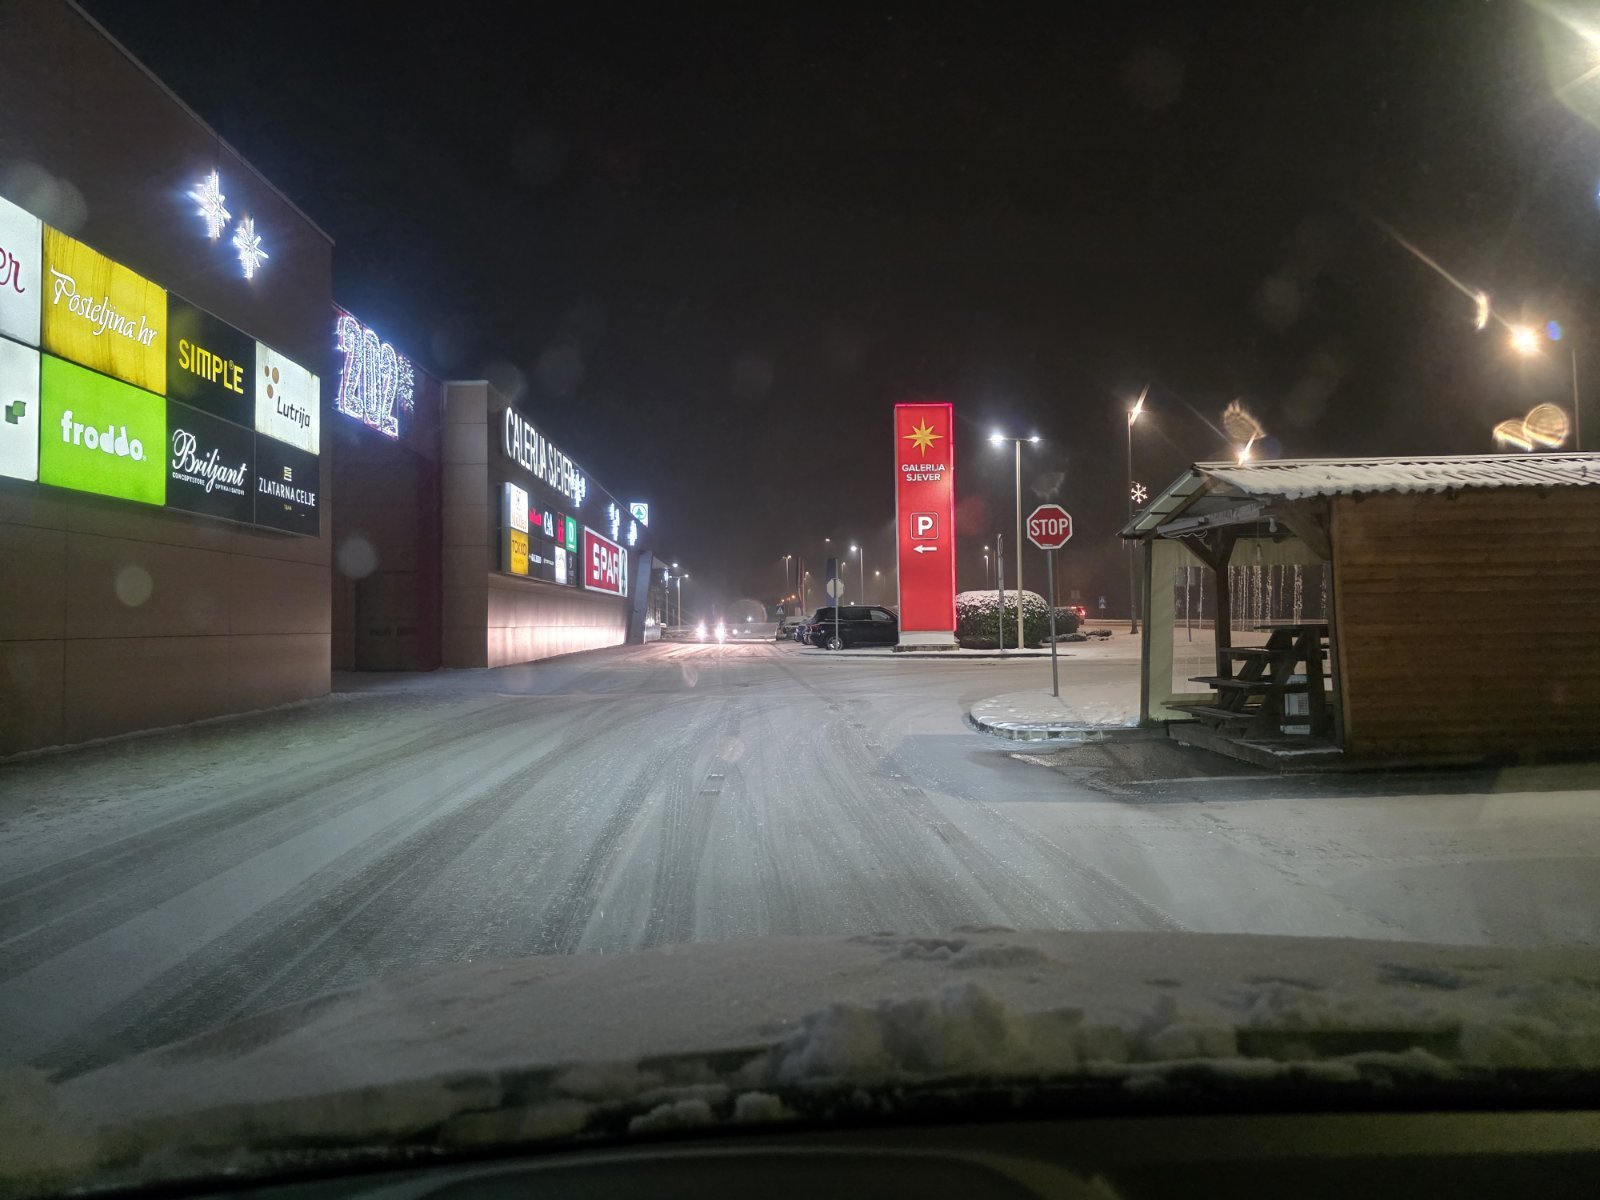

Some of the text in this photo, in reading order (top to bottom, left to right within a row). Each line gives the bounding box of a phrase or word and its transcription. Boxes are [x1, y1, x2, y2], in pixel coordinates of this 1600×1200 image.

[51, 264, 158, 347] Posteljina.hr
[276, 396, 311, 429] Lutrija
[172, 428, 248, 494] Briljant
[901, 463, 946, 473] GALERIJA
[258, 477, 316, 507] ZLATARNA CELJE
[906, 473, 941, 482] SJEVER
[1030, 518, 1069, 537] STOP
[593, 542, 619, 585] SPAR
